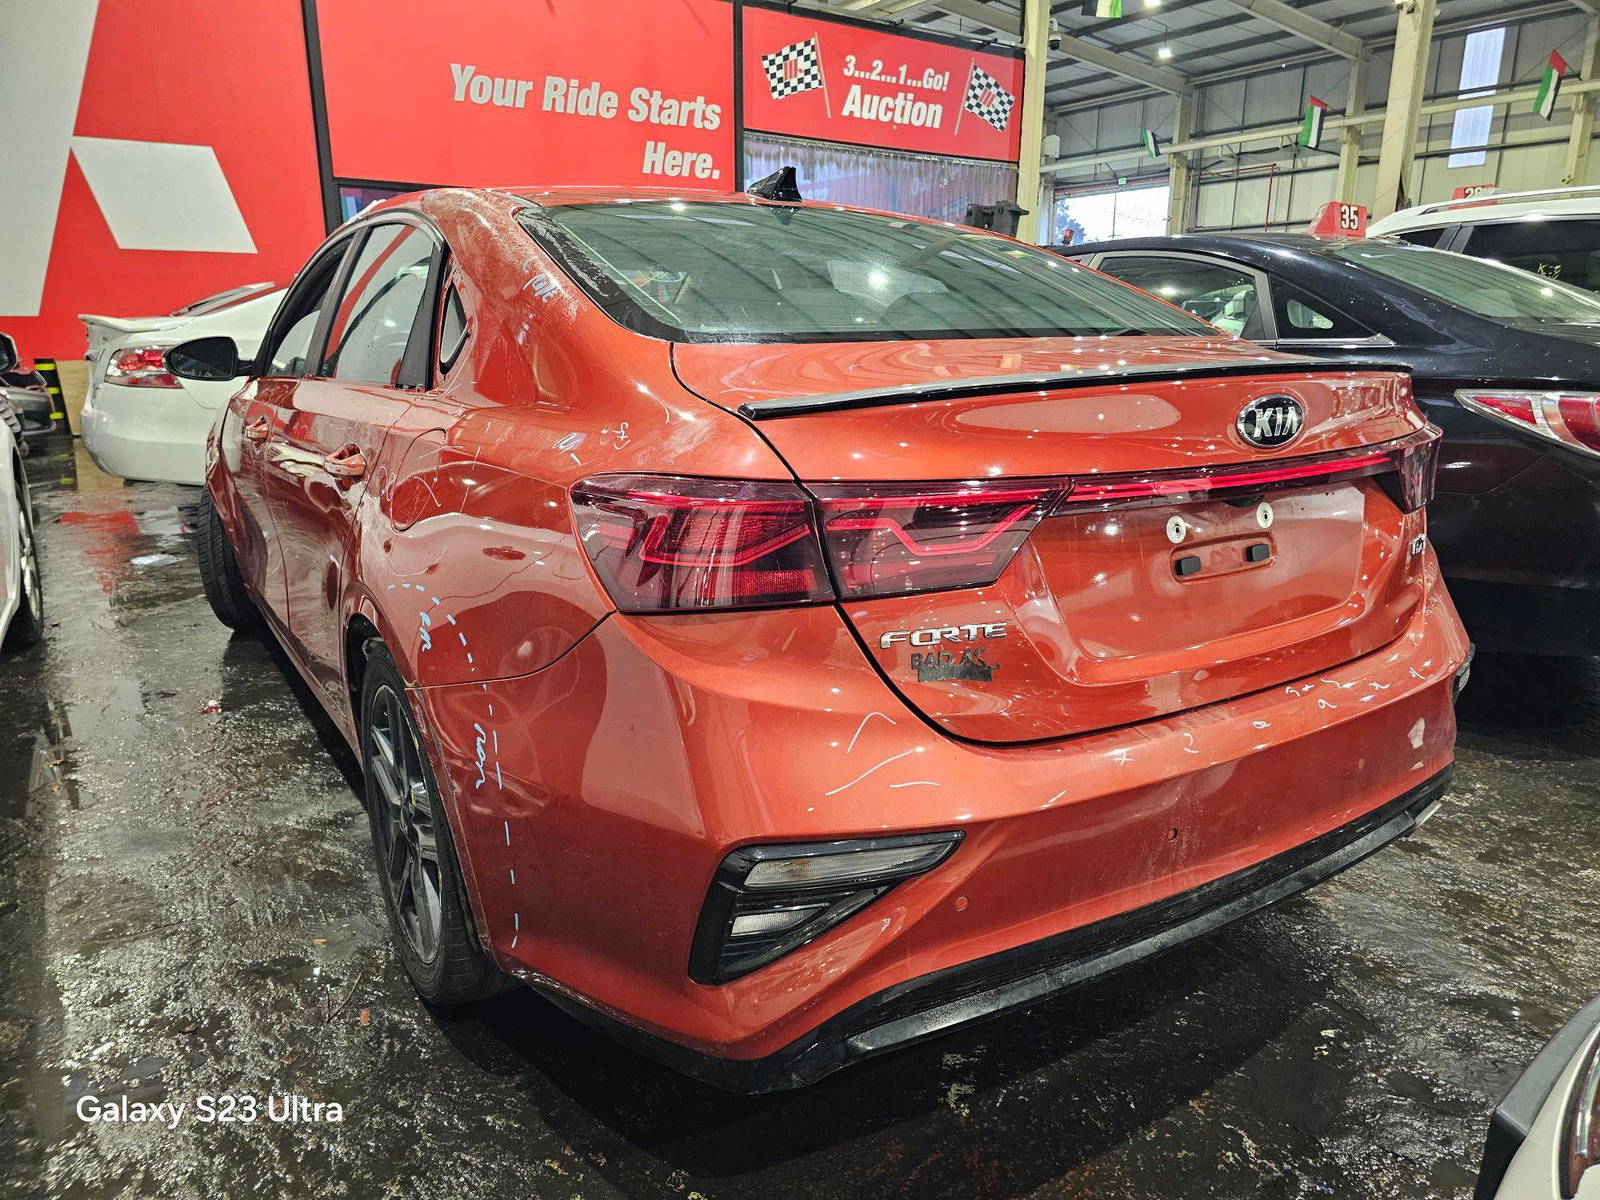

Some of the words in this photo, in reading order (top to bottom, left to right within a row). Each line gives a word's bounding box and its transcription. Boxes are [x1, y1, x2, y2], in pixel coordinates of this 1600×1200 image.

[843, 54, 950, 92] 3...2...1...Go!
[450, 63, 534, 108] Your
[541, 75, 619, 119] Ride
[627, 86, 722, 131] Starts
[841, 84, 943, 129] Auction
[641, 140, 721, 180] Here.
[1341, 204, 1359, 231] 35
[1252, 406, 1299, 438] KIA
[880, 622, 1008, 649] FORTE
